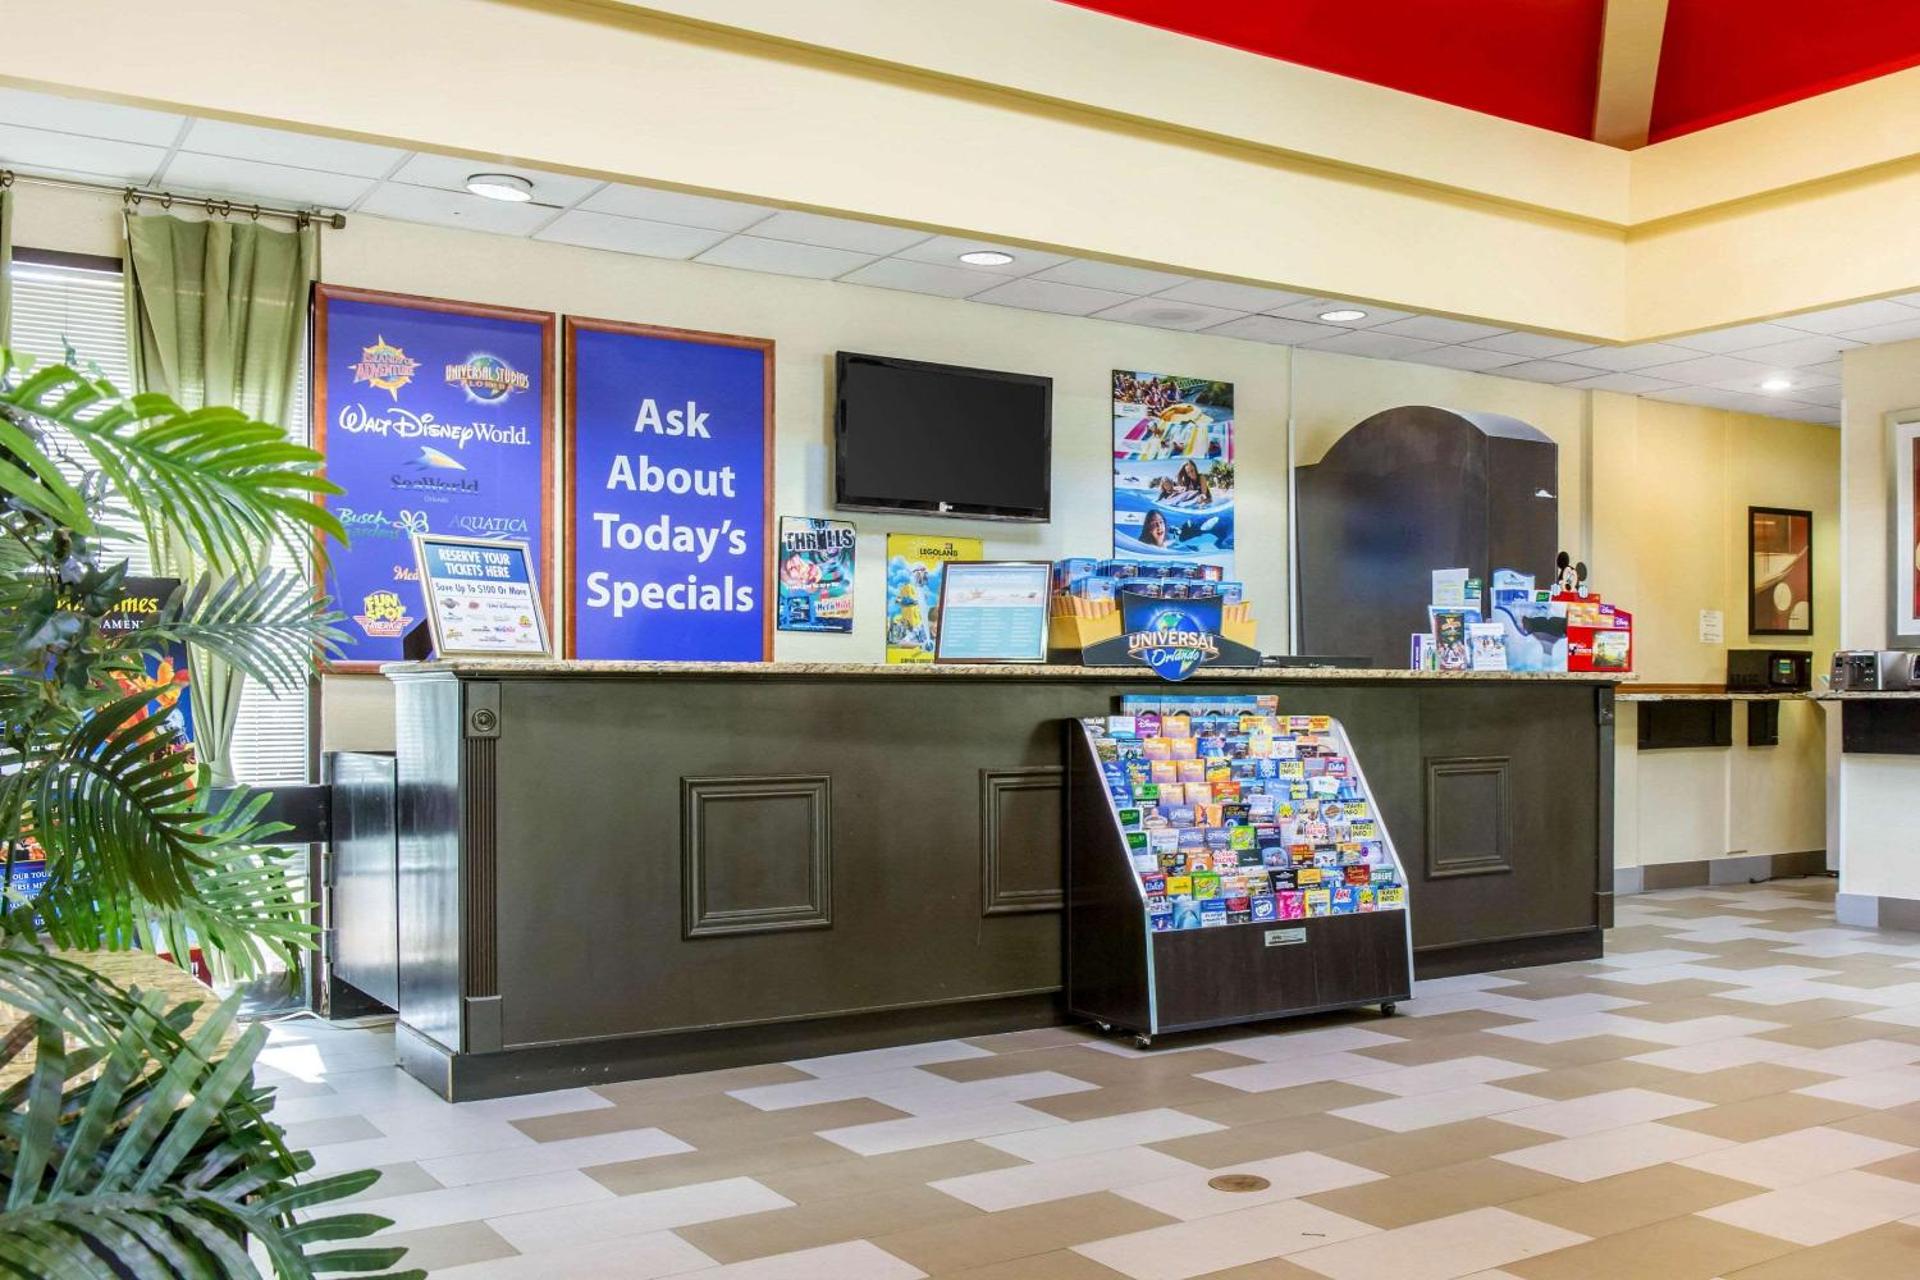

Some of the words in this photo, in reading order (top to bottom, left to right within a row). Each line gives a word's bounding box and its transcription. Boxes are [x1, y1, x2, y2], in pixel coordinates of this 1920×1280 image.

[445, 364, 492, 382] UNIVERSAL
[495, 366, 530, 389] STUDIOS
[634, 398, 711, 439] Ask
[390, 475, 480, 494] SeaWorld
[606, 454, 736, 498] About
[336, 508, 391, 531] Busch
[449, 512, 528, 532] AQUATICA
[593, 512, 747, 562] Today's
[438, 549, 481, 563] RESERVE
[481, 551, 511, 566] YOUR
[919, 547, 958, 557] LEGOLAND
[445, 563, 483, 577] TICKETS
[485, 566, 511, 578] HERE
[435, 582, 452, 592] Save
[455, 584, 465, 595] Up
[467, 584, 476, 593] To
[509, 586, 527, 596] More
[585, 571, 754, 618] Specials
[364, 594, 398, 608] FUN
[366, 606, 407, 621] SPOT
[1128, 632, 1219, 651] UNIVERSAL
[1151, 648, 1200, 667] Orlando
